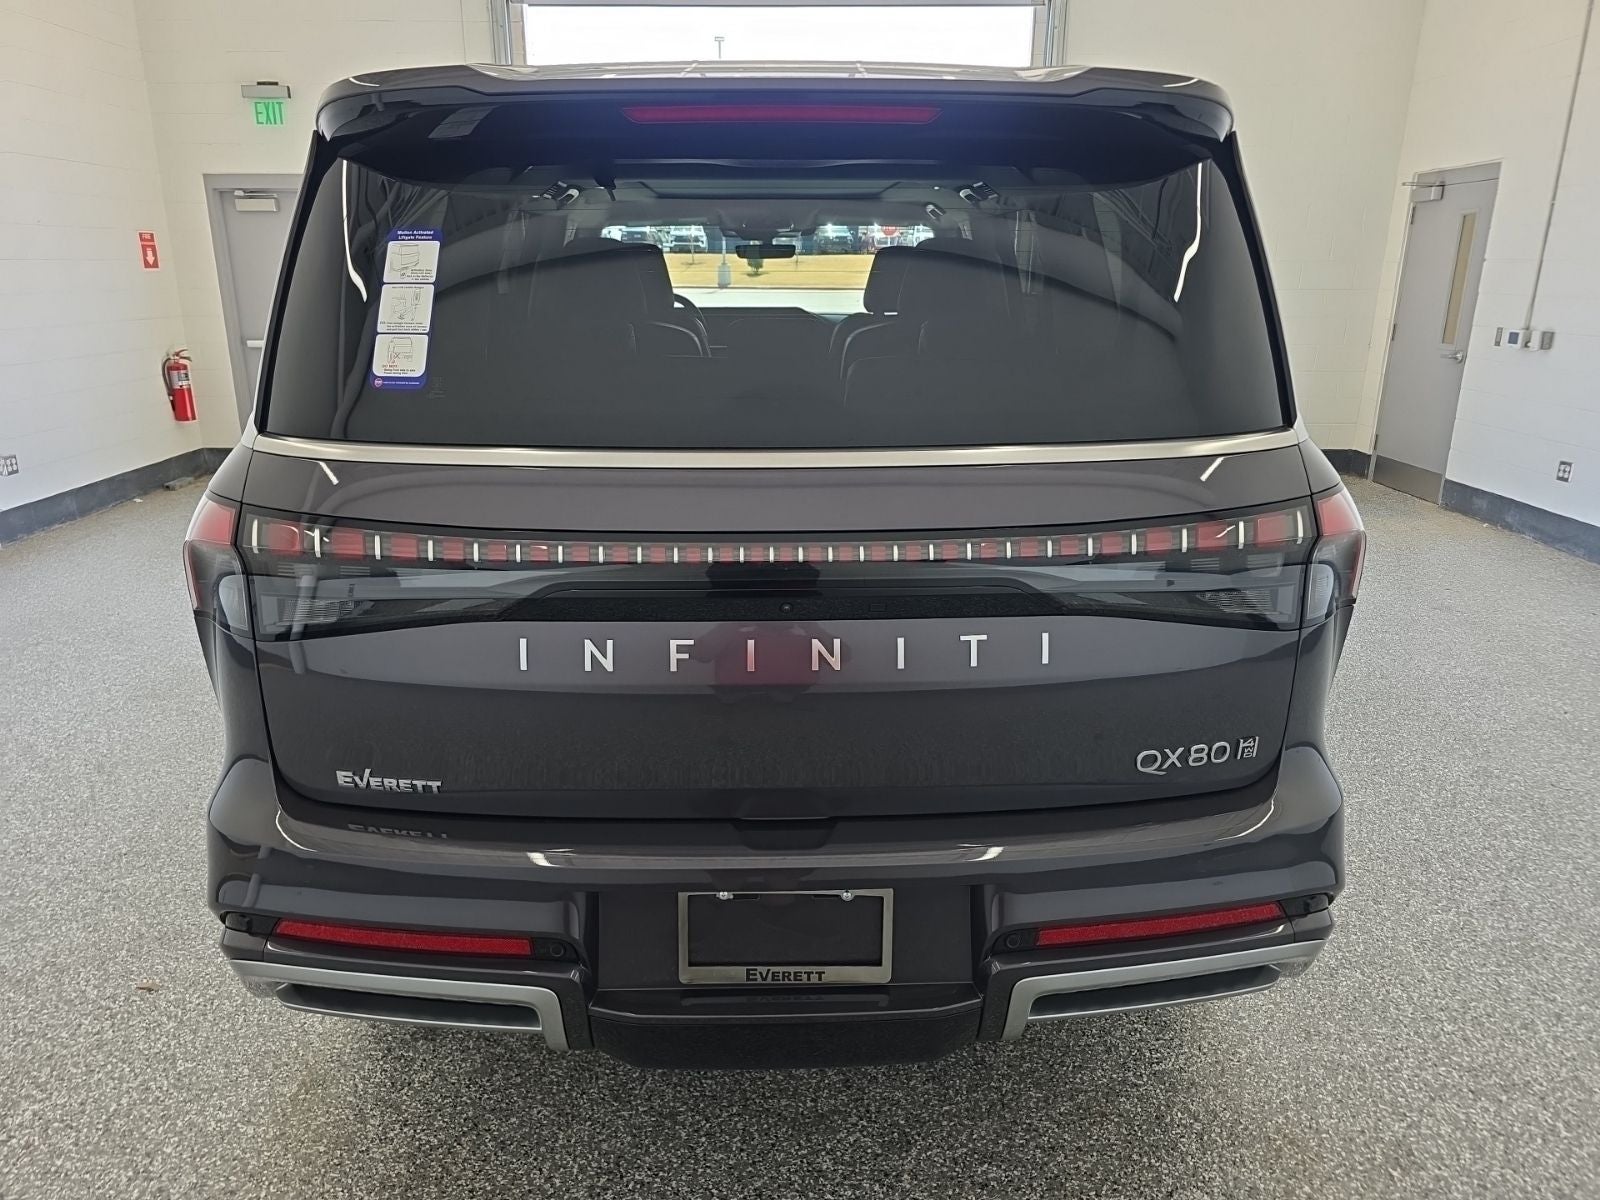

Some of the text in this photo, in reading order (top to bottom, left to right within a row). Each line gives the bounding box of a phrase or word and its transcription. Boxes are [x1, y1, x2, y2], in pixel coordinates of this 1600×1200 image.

[254, 101, 284, 125] EXIT
[519, 631, 1050, 672] INFINITI
[1136, 741, 1231, 776] QX80
[335, 768, 442, 794] EVERETT
[745, 967, 826, 983] EVERETT
